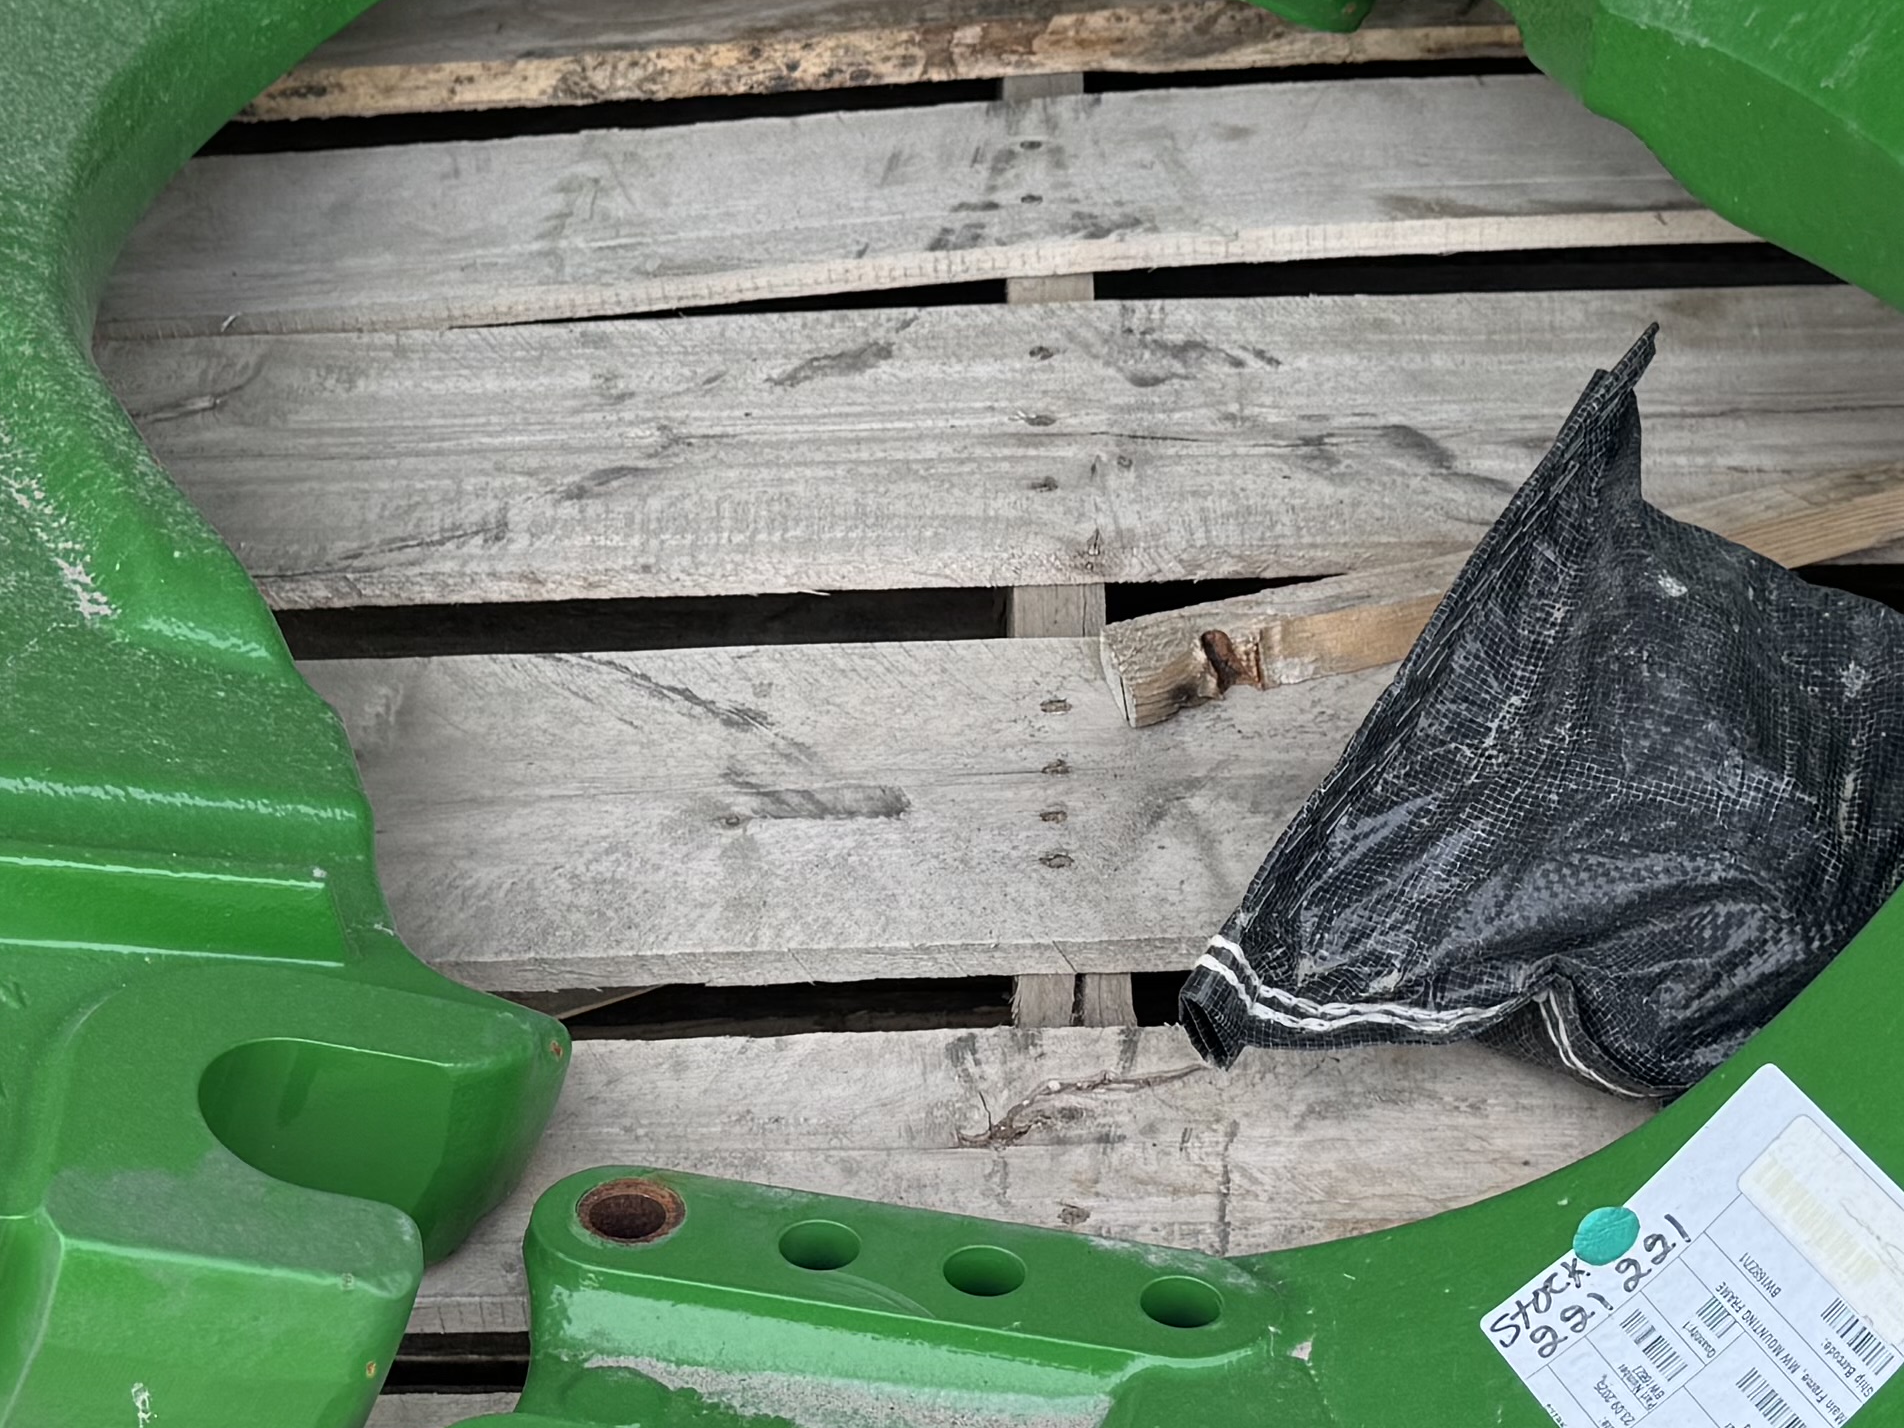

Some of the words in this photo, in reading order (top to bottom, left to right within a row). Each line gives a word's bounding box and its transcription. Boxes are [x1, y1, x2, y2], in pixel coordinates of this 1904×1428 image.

[1713, 1280, 1747, 1313] FRAME
[1738, 1308, 1787, 1356] MOUNTING
[1778, 1351, 1801, 1373] MW
[1816, 1336, 1857, 1378] Barcode:
[1795, 1367, 1830, 1403] Frame,
[1850, 1371, 1877, 1398] Ship
[1821, 1397, 1849, 1425] Main
